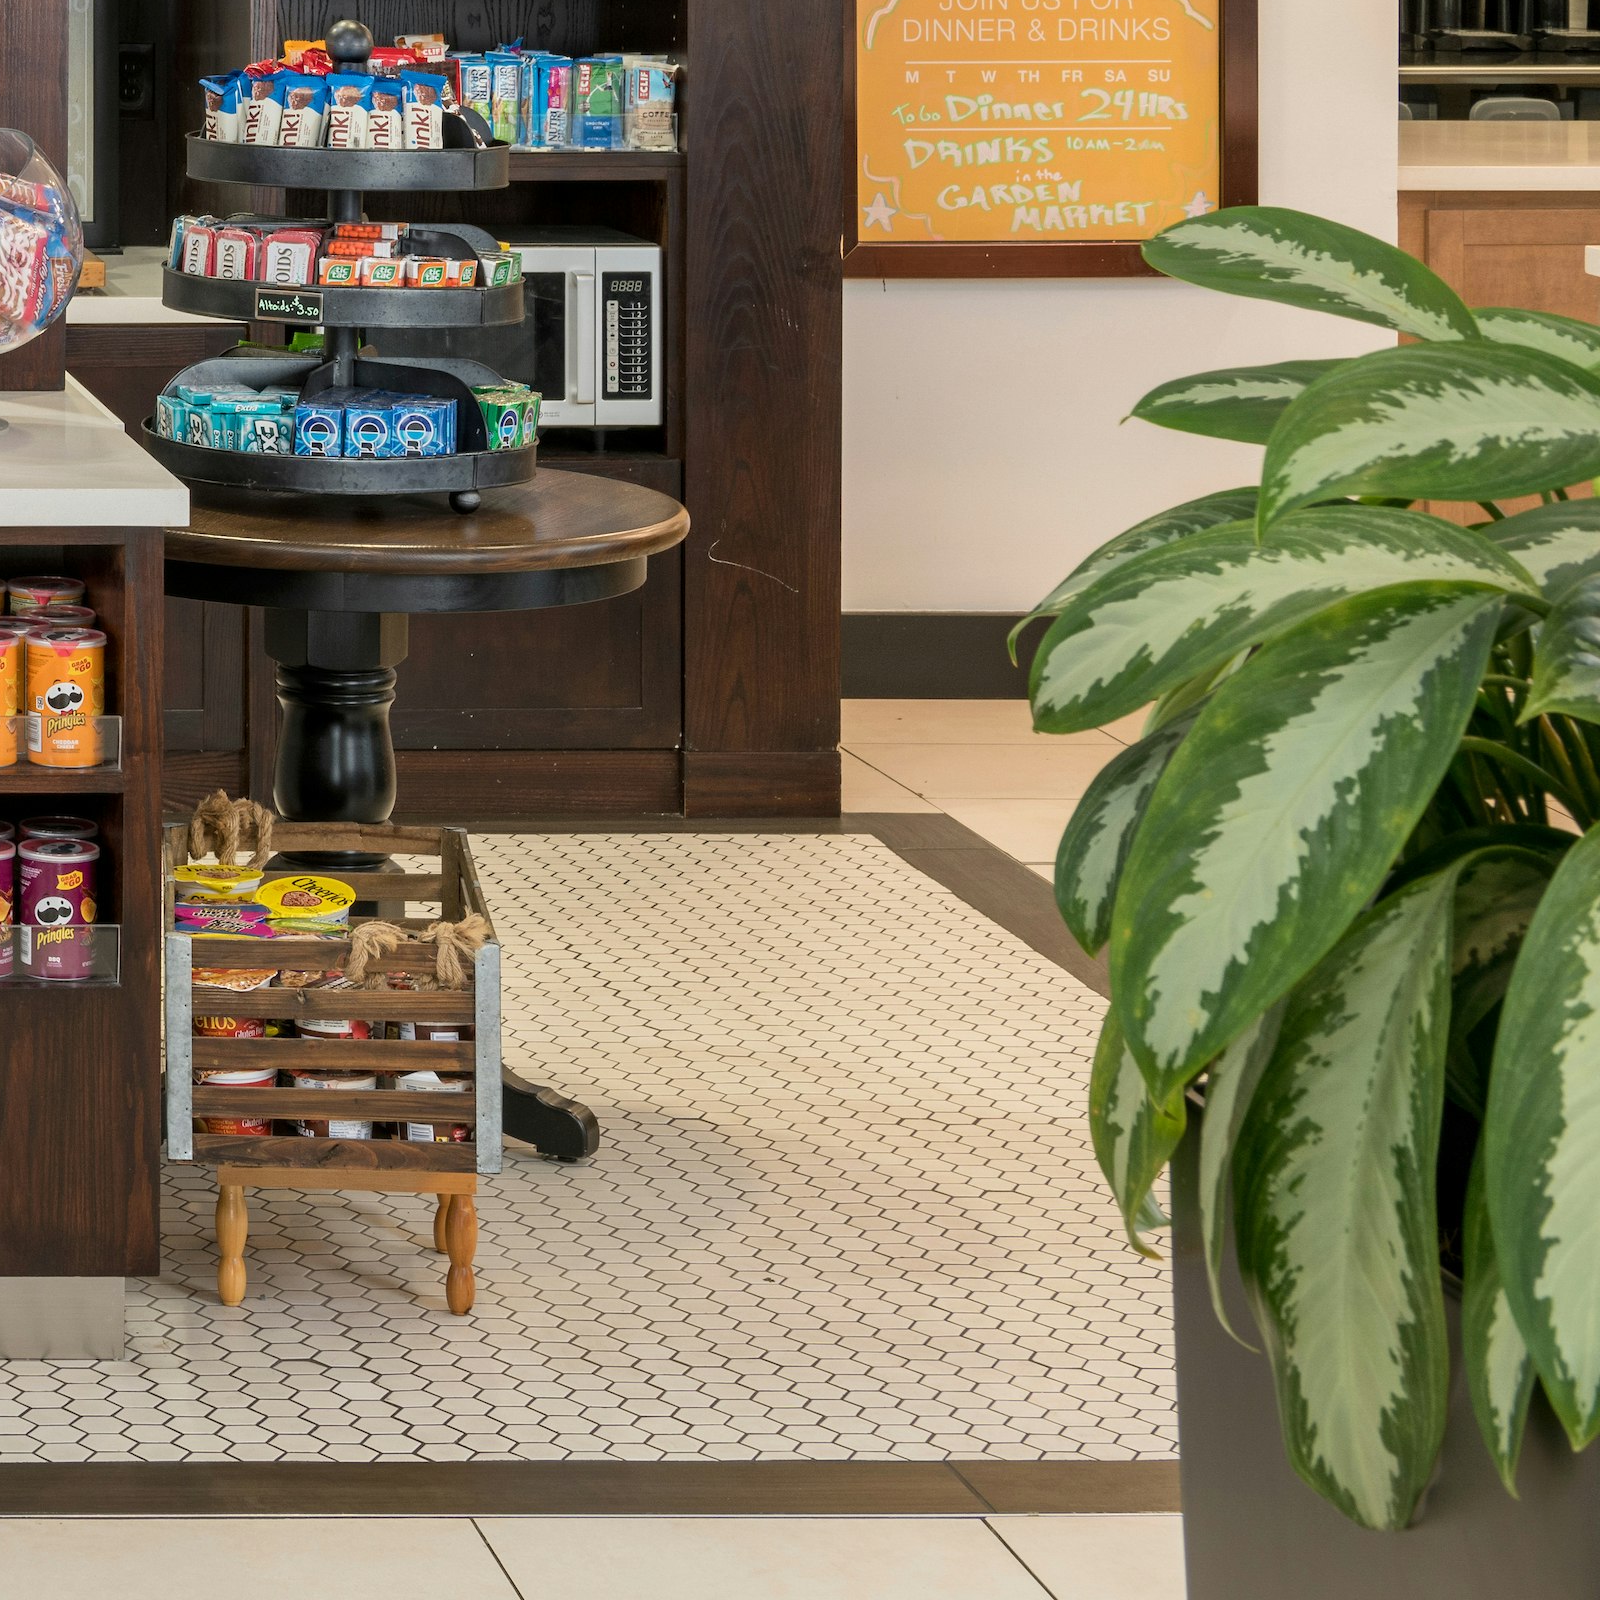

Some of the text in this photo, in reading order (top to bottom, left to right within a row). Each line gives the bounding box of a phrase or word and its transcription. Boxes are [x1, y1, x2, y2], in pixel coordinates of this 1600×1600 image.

[903, 18, 1171, 42] DINNER & DRINKS
[422, 48, 443, 56] CLIF
[905, 69, 1170, 83] M T W TH FR SA SU
[1076, 87, 1134, 122] 24
[902, 136, 1055, 170] DRINKS
[1016, 168, 1063, 182] in the
[937, 179, 1083, 211] GARDEN
[292, 877, 353, 906] Cheerios
[36, 925, 75, 950] Pringles
